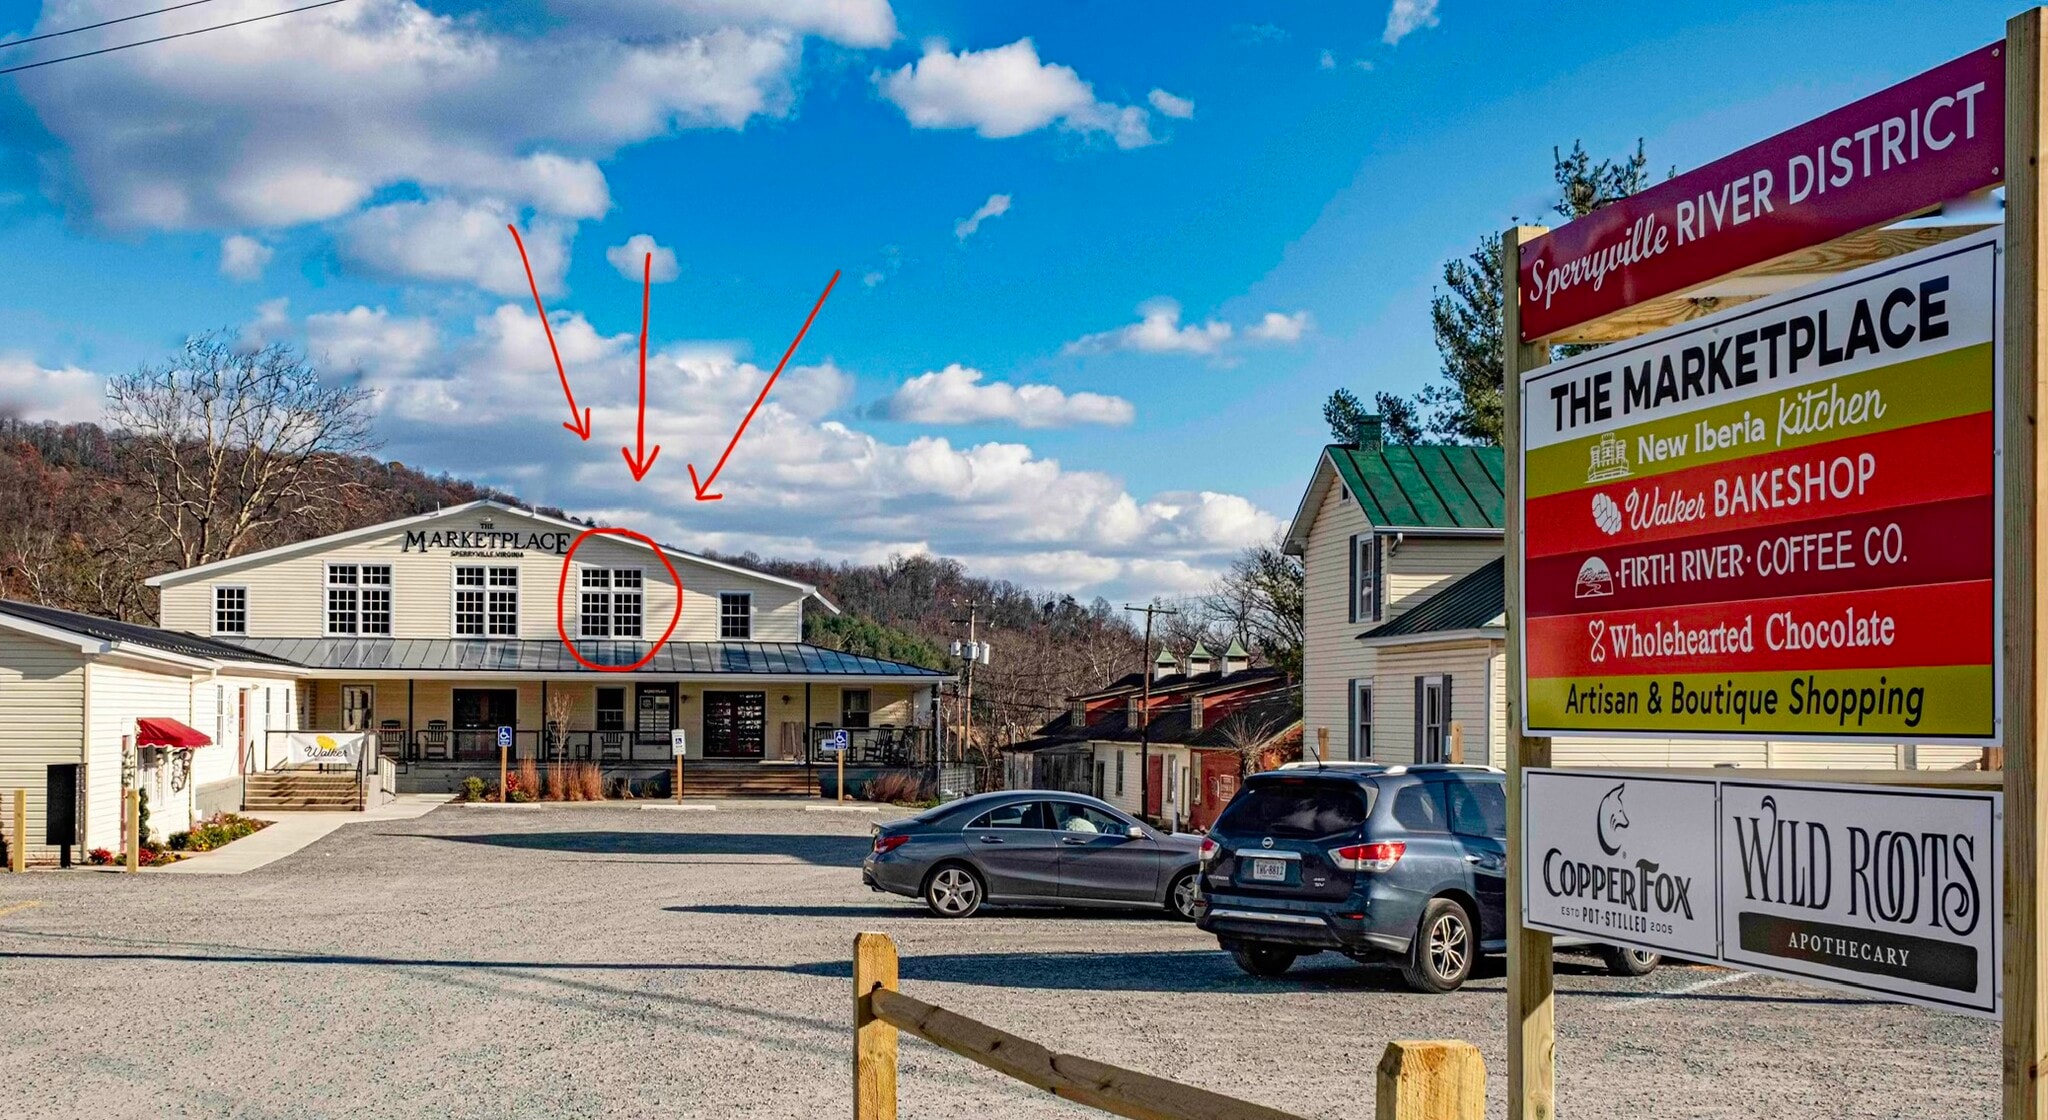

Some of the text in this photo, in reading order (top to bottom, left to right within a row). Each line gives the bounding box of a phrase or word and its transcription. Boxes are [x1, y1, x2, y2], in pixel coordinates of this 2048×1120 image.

[1529, 81, 1986, 309] Sperryville RIVER DISTRICT
[1550, 275, 1950, 432] THE MARKETPLACE
[1637, 433, 1688, 465] New
[1695, 411, 1766, 454] Iberia
[1625, 452, 1876, 530] Walker BAKESHOP
[403, 530, 571, 555] MARKETPLACE
[1756, 530, 1856, 577] COFFEE
[1863, 522, 1908, 566] CO.
[1609, 607, 1895, 658] Wholehearted Chocolate
[1565, 676, 1926, 729] Artisan & Boutique Shopping
[304, 745, 348, 757] Walker
[1732, 794, 1981, 937] WILD ROOTS
[1561, 906, 1673, 935] ESTD POT-STILLED 2005
[1788, 930, 1912, 967] APOTHECARY
